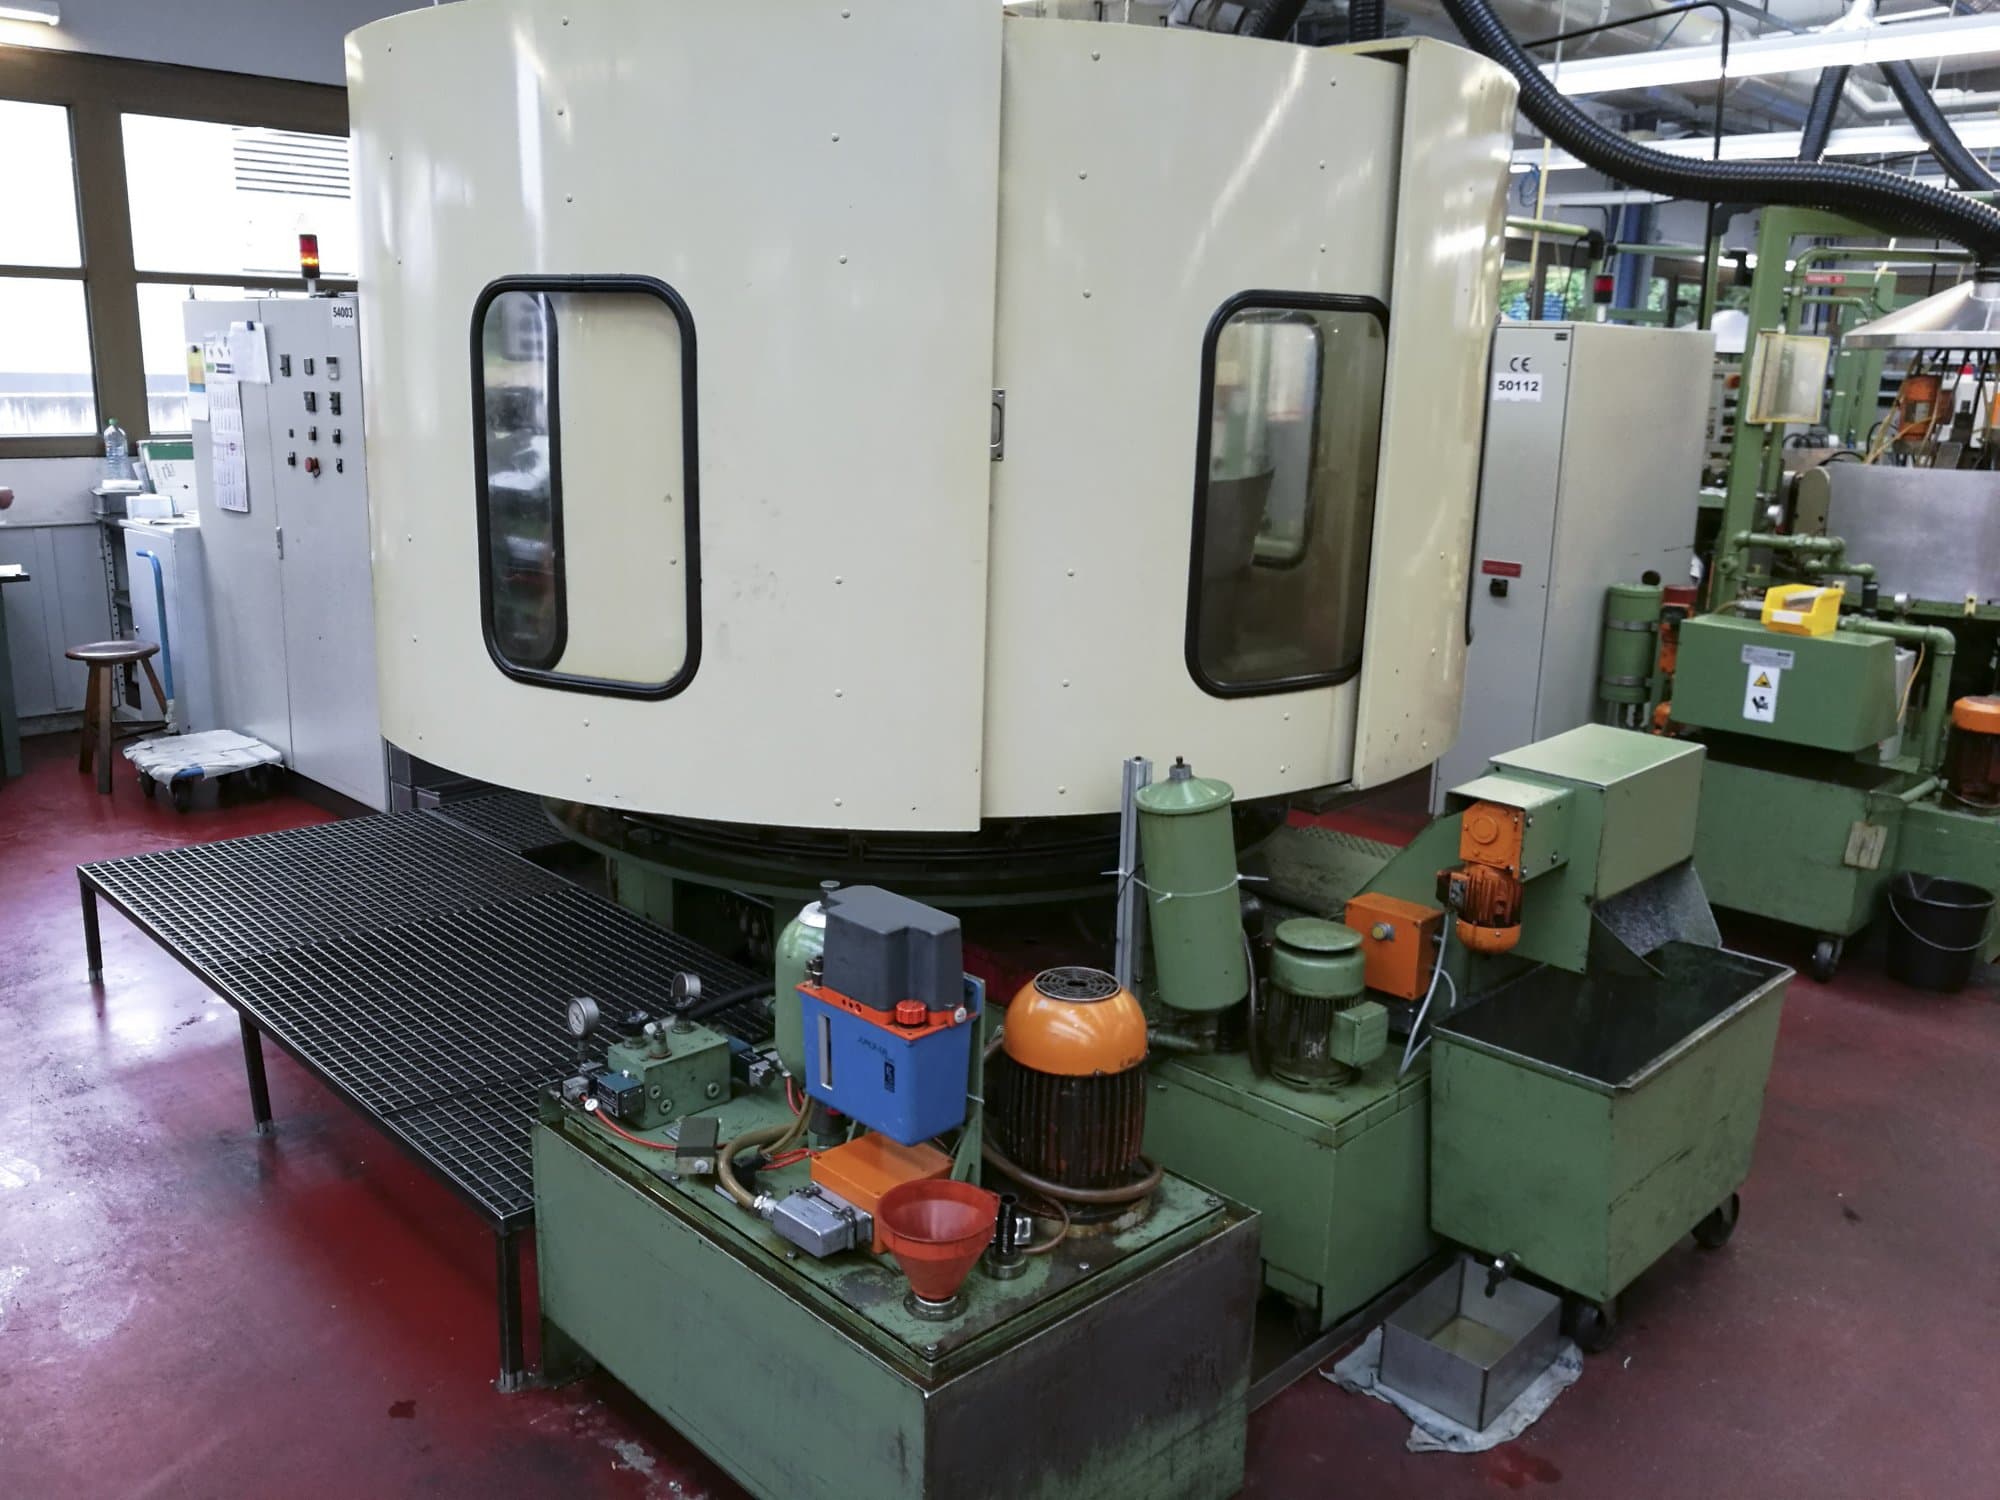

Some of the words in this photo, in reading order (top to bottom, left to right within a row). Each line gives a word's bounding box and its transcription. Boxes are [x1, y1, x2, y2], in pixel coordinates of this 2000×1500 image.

[333, 306, 353, 318] 54003
[1510, 357, 1532, 372] CE
[1498, 380, 1539, 392] 50112
